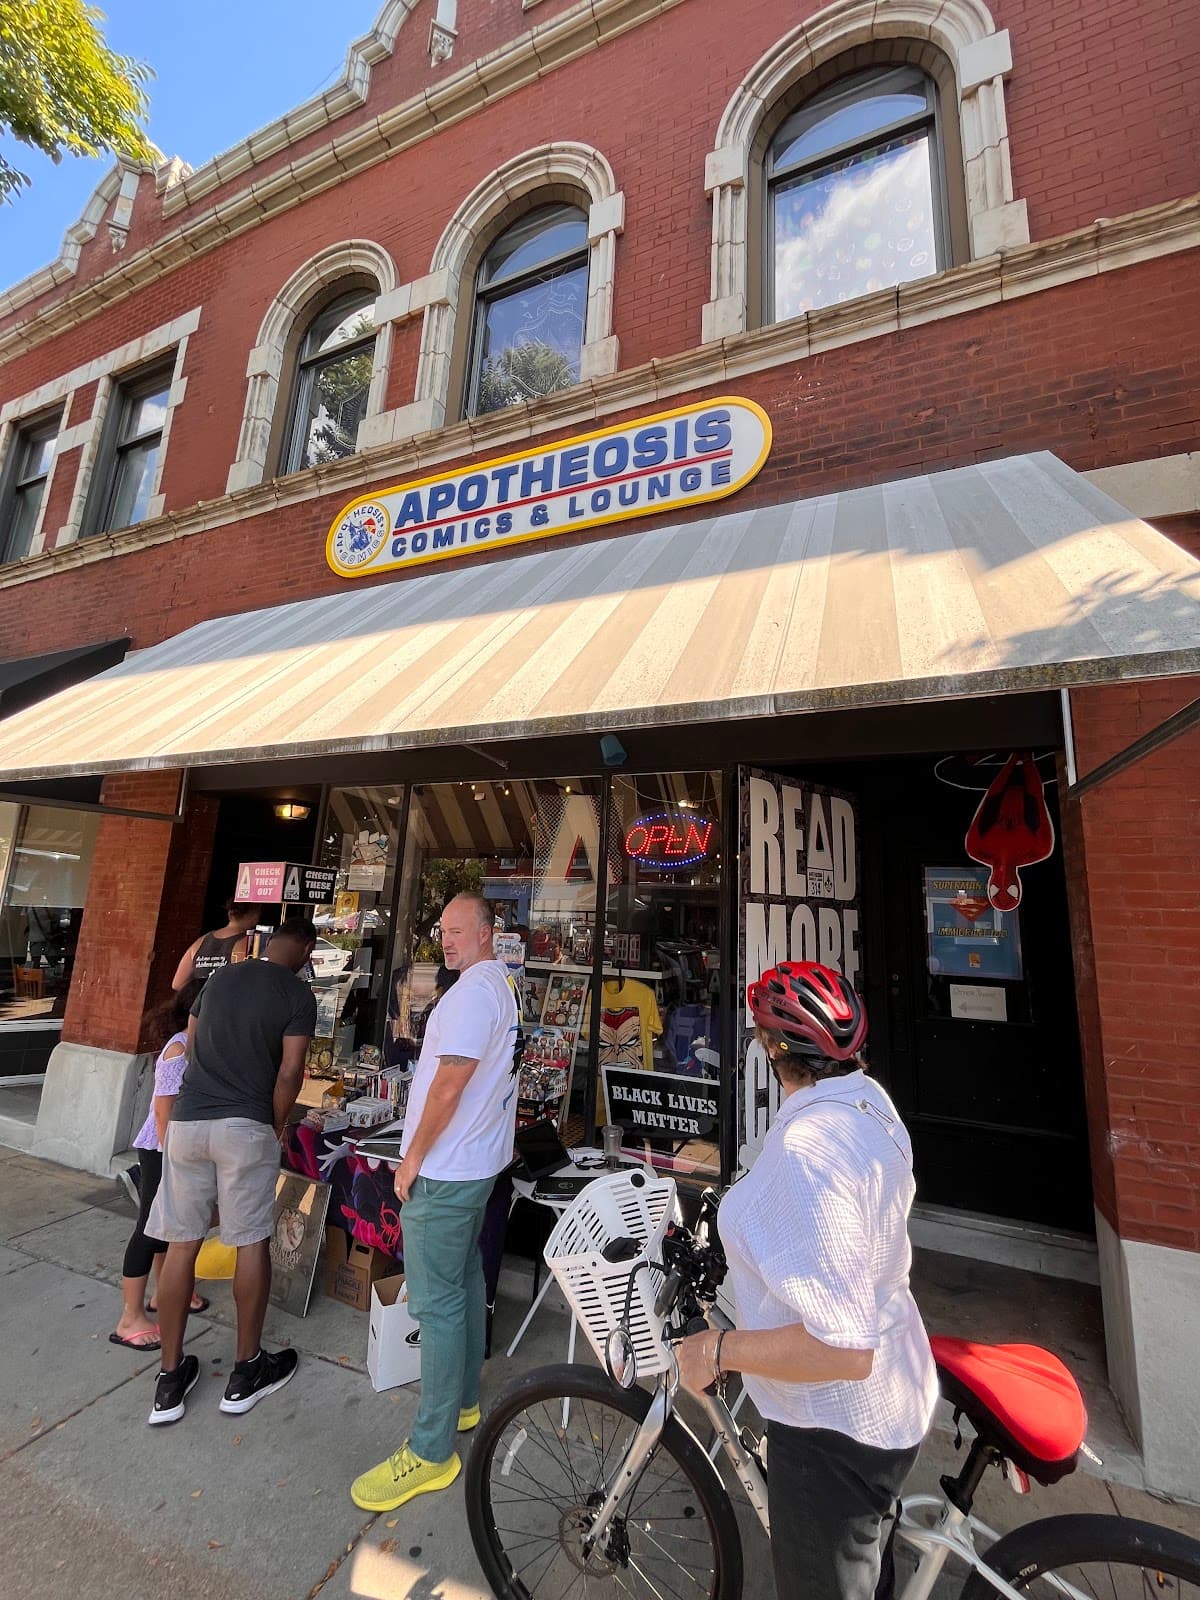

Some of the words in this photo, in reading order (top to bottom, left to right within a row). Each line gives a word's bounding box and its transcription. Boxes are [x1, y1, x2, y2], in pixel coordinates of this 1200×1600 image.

[395, 409, 733, 529] APOTHEOSIS
[391, 511, 512, 557] COMICS
[530, 503, 549, 526] &
[568, 460, 732, 518] LOUNGE
[625, 822, 712, 855] OPEN
[749, 777, 857, 901] READ
[254, 867, 281, 876] CHECK
[254, 877, 279, 886] THESE
[305, 870, 335, 881] CHECK
[257, 887, 274, 896] OUT
[305, 880, 332, 890] THESE
[308, 890, 327, 899] OUT
[611, 1085, 662, 1106] BLACK
[667, 1093, 718, 1116] LIVES
[631, 1109, 701, 1135] MATTER
[718, 1431, 771, 1530] MARI
